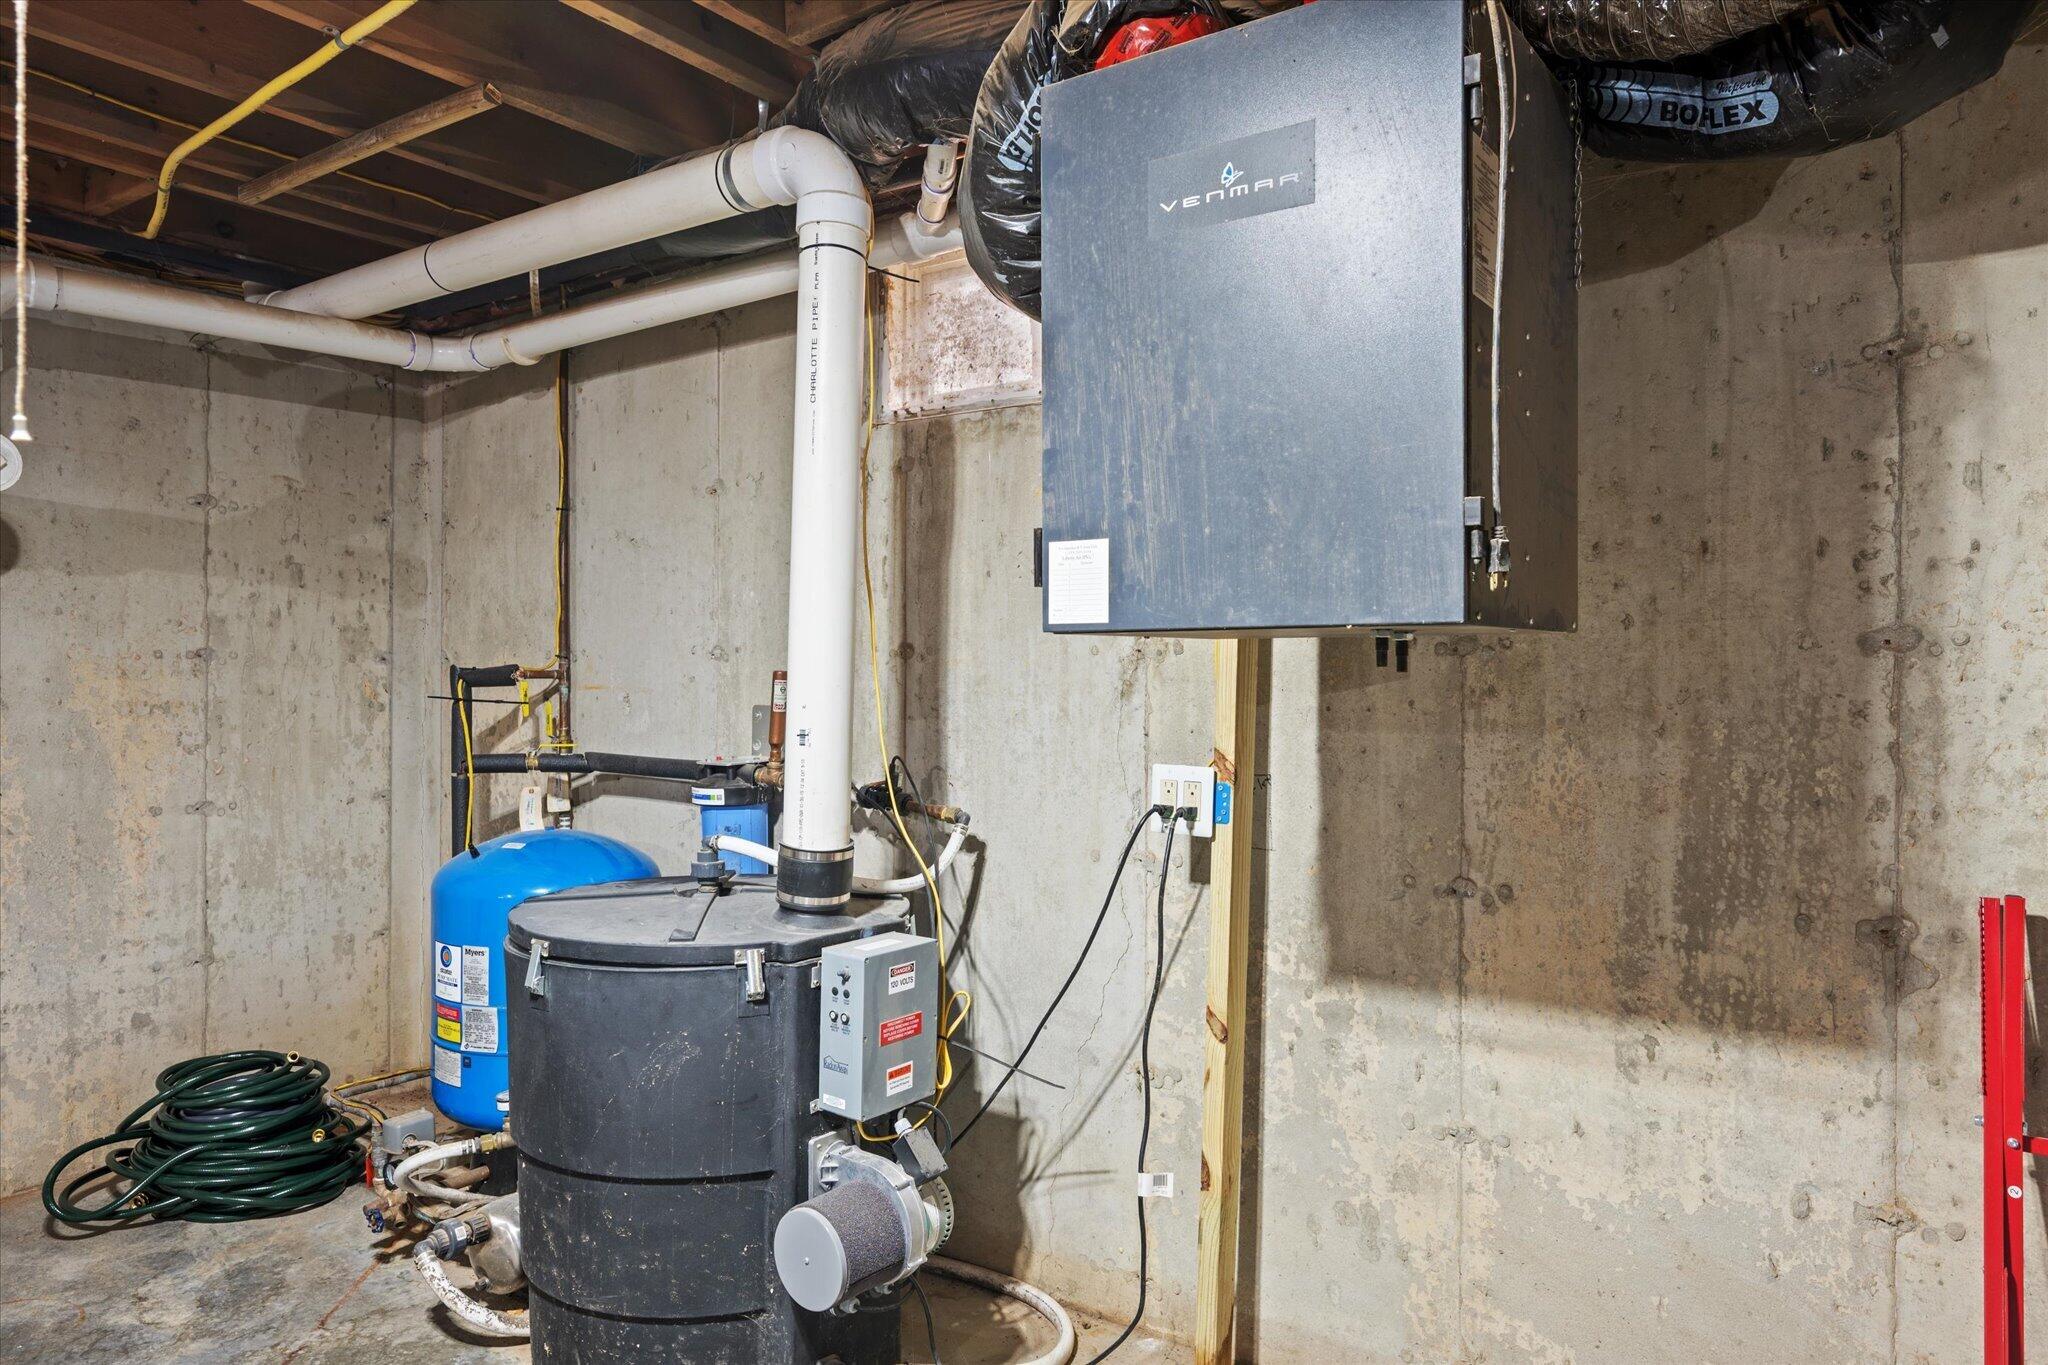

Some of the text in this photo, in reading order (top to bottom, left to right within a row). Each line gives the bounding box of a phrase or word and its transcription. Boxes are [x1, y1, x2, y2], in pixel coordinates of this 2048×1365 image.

[1715, 73, 1767, 95] Imperial
[1660, 99, 1767, 129] BOFLEX
[1159, 172, 1300, 213] VENMAR
[809, 338, 818, 403] CHARLOTTE
[464, 948, 485, 957] Myers
[900, 976, 914, 986] VOLTS
